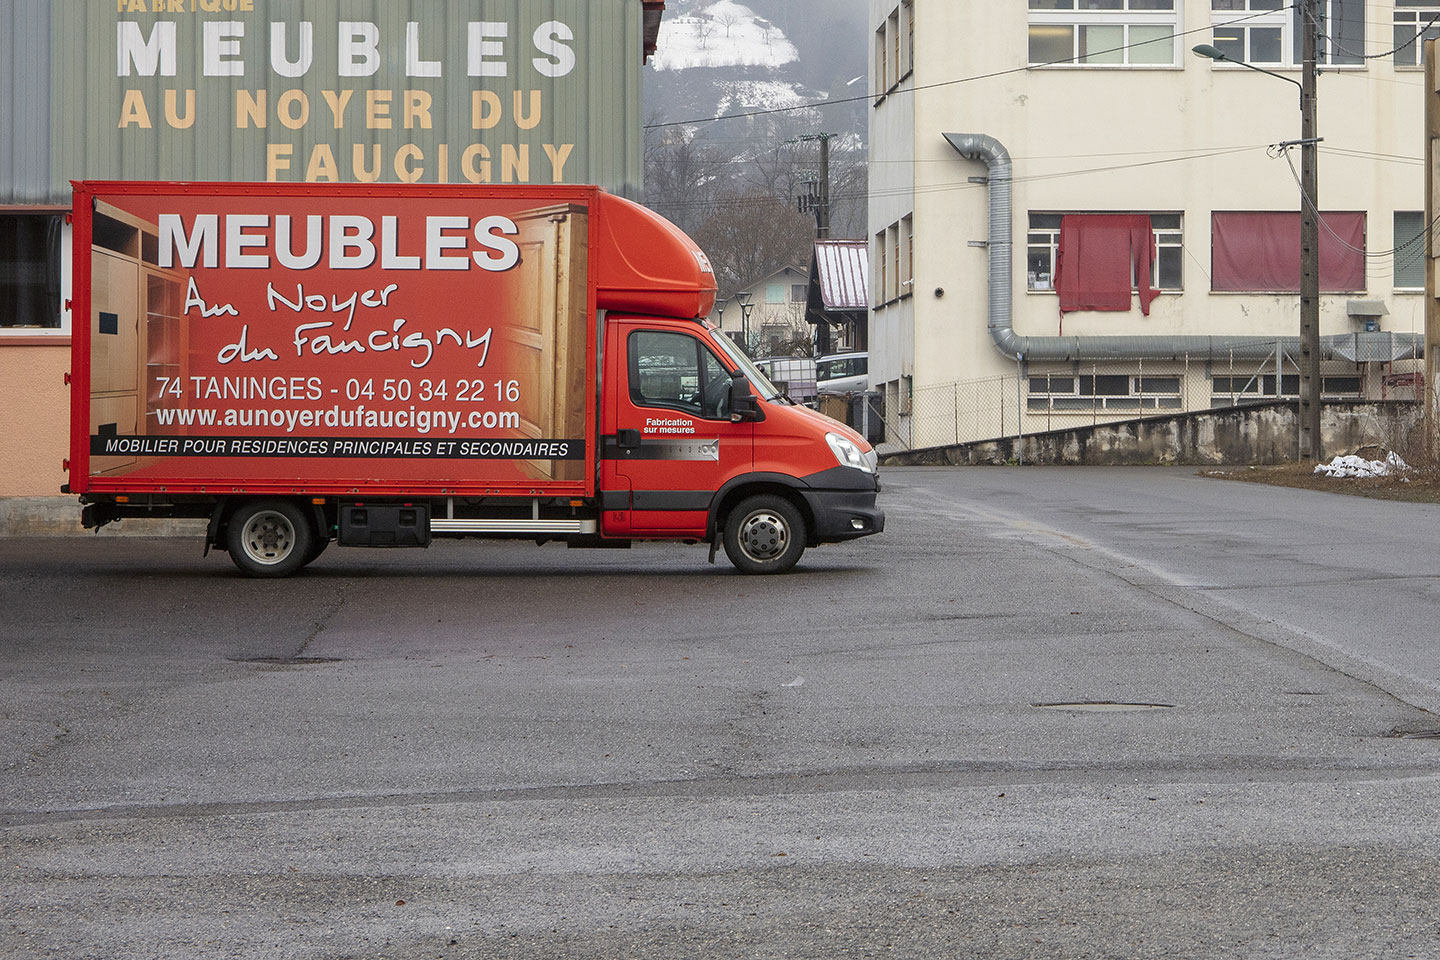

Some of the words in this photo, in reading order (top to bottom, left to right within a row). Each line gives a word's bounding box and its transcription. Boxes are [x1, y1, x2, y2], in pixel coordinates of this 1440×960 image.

[116, 20, 576, 78] MEUBLES
[118, 89, 196, 129] AU
[236, 89, 432, 130] NOYER
[471, 90, 542, 130] DU
[266, 143, 574, 183] FAUCIGNY
[158, 213, 519, 271] MEUBLES
[184, 276, 239, 318] Au
[267, 282, 398, 331] Noyer
[217, 324, 278, 364] du
[293, 318, 492, 368] Faucigny
[156, 376, 183, 399] 74
[190, 376, 323, 401] TANINGES
[346, 378, 376, 401] 04
[382, 378, 412, 401] 50
[418, 378, 449, 402] 34
[455, 379, 485, 402] 22
[493, 379, 520, 402] 16
[156, 405, 520, 434] www.aunoyerdufaucigny.com
[643, 426, 658, 434] sur
[659, 426, 695, 434] mesures
[646, 418, 693, 426] Fabrication
[105, 439, 179, 453] MOBILIER
[183, 439, 226, 453] POUR
[230, 440, 329, 454] RESIDENCES
[332, 441, 432, 455] PRINCIPALES
[436, 442, 457, 455] ET
[459, 443, 569, 457] SECONDAIRES
